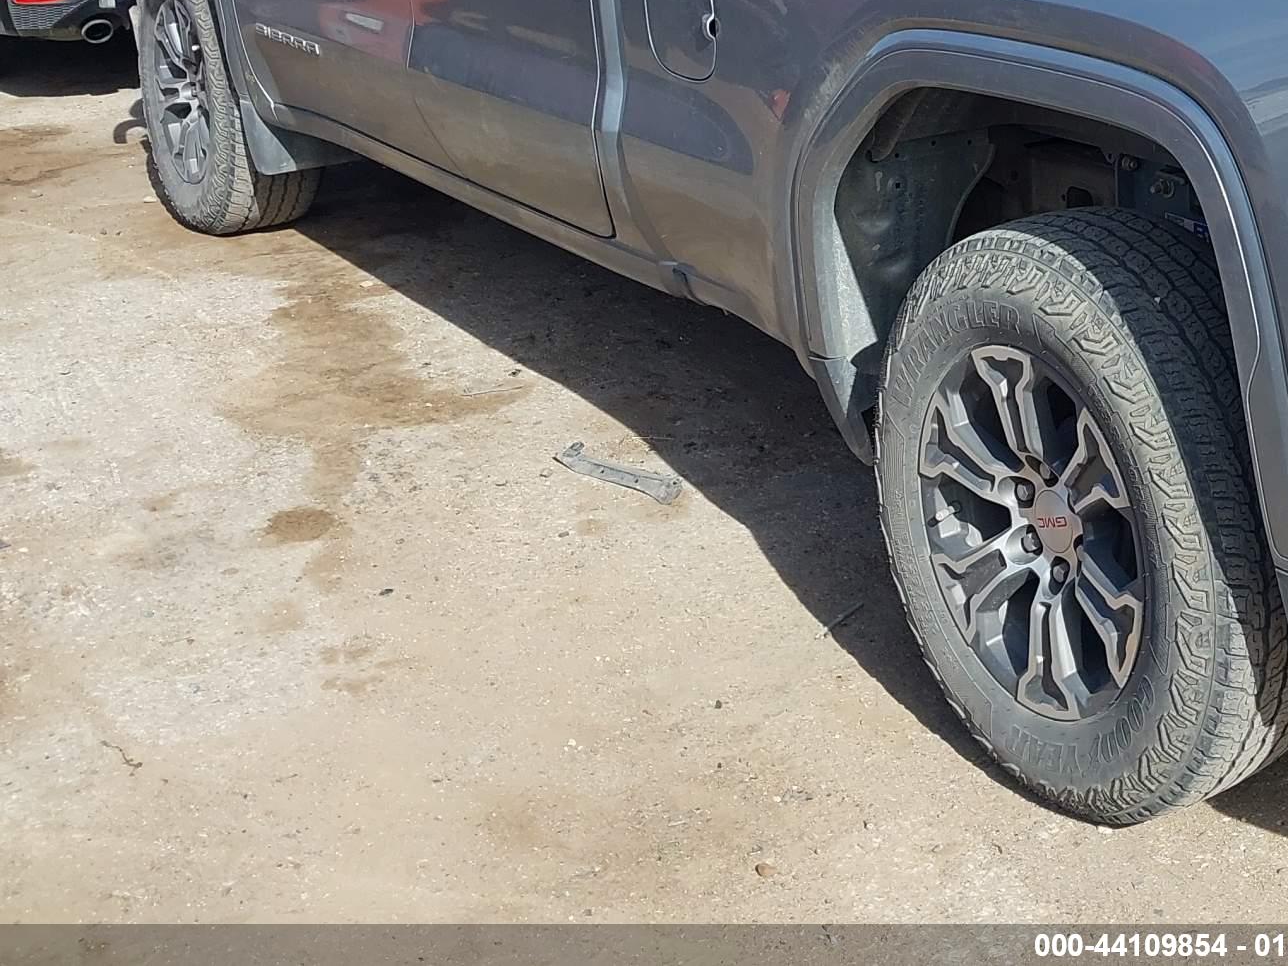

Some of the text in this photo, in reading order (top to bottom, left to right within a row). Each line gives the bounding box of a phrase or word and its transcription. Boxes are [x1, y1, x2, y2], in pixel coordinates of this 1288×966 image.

[255, 22, 321, 55] SIERRA
[890, 298, 1021, 410] WRANGLER
[1036, 515, 1068, 529] GMC
